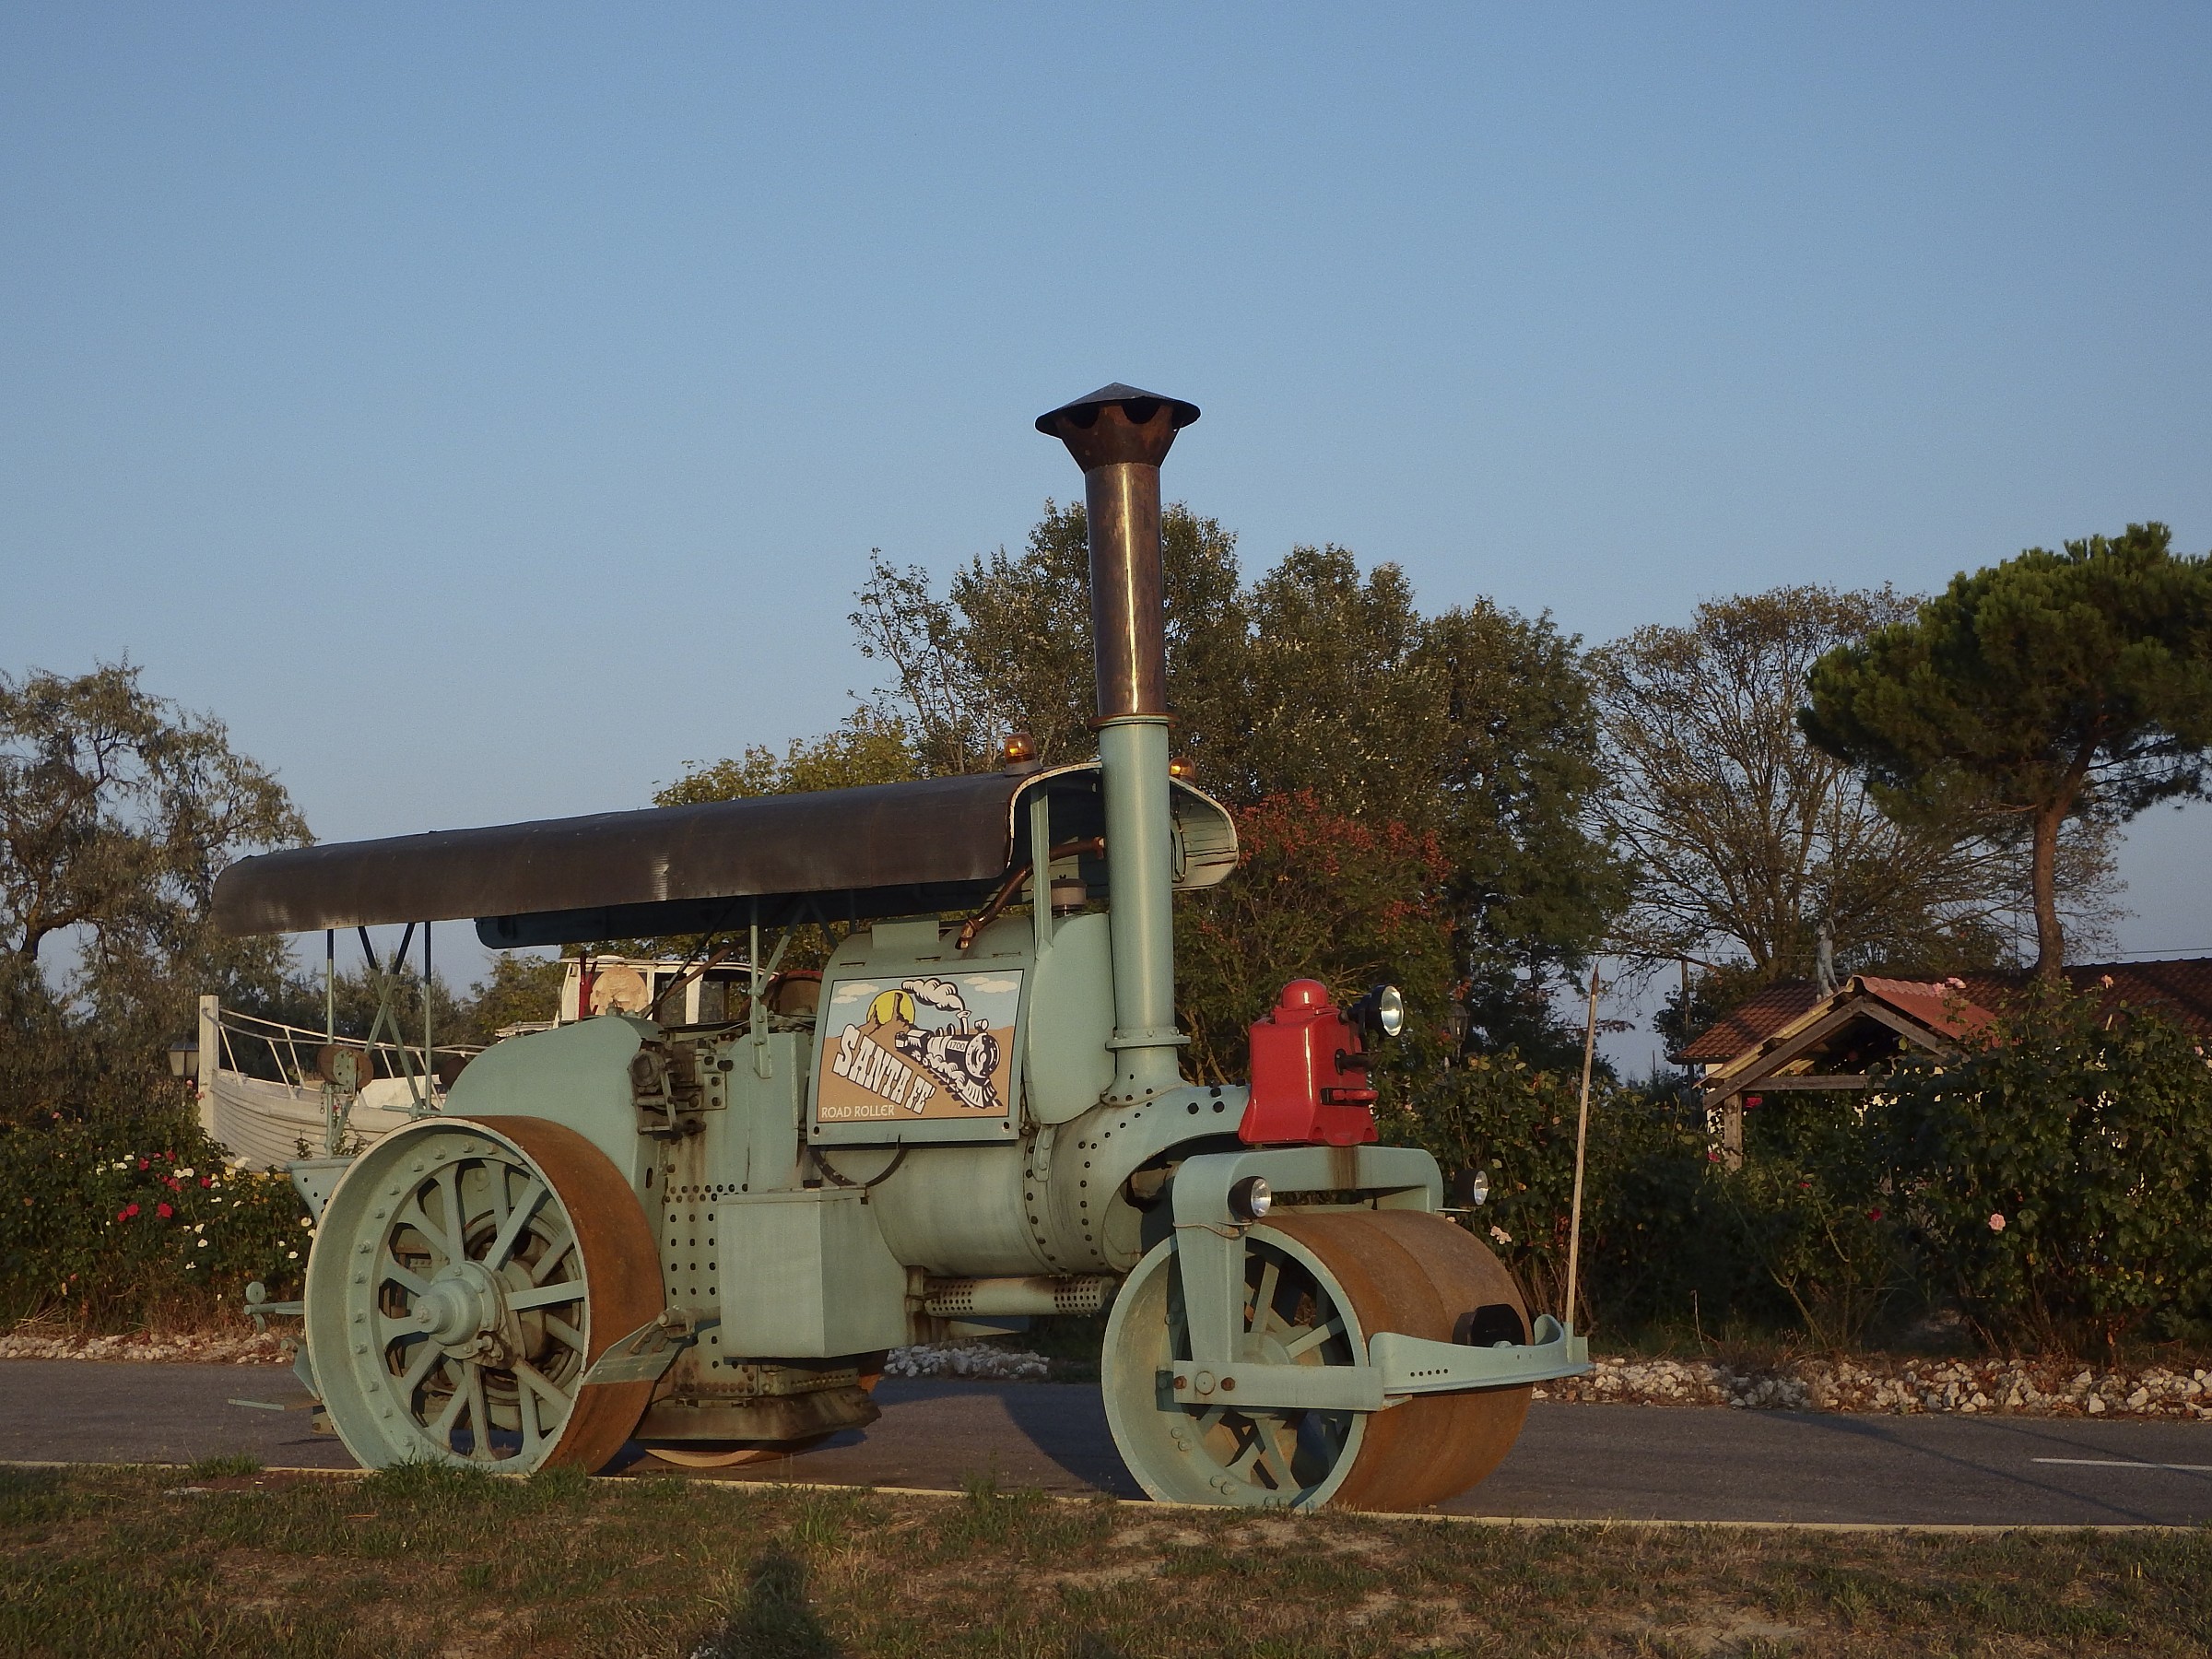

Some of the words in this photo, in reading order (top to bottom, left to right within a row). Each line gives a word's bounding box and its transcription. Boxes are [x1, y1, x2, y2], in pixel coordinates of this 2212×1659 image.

[949, 1041, 965, 1050] 1700
[832, 1023, 913, 1105] SANTA
[821, 1106, 852, 1118] ROAD
[854, 1104, 895, 1117] ROLLER
